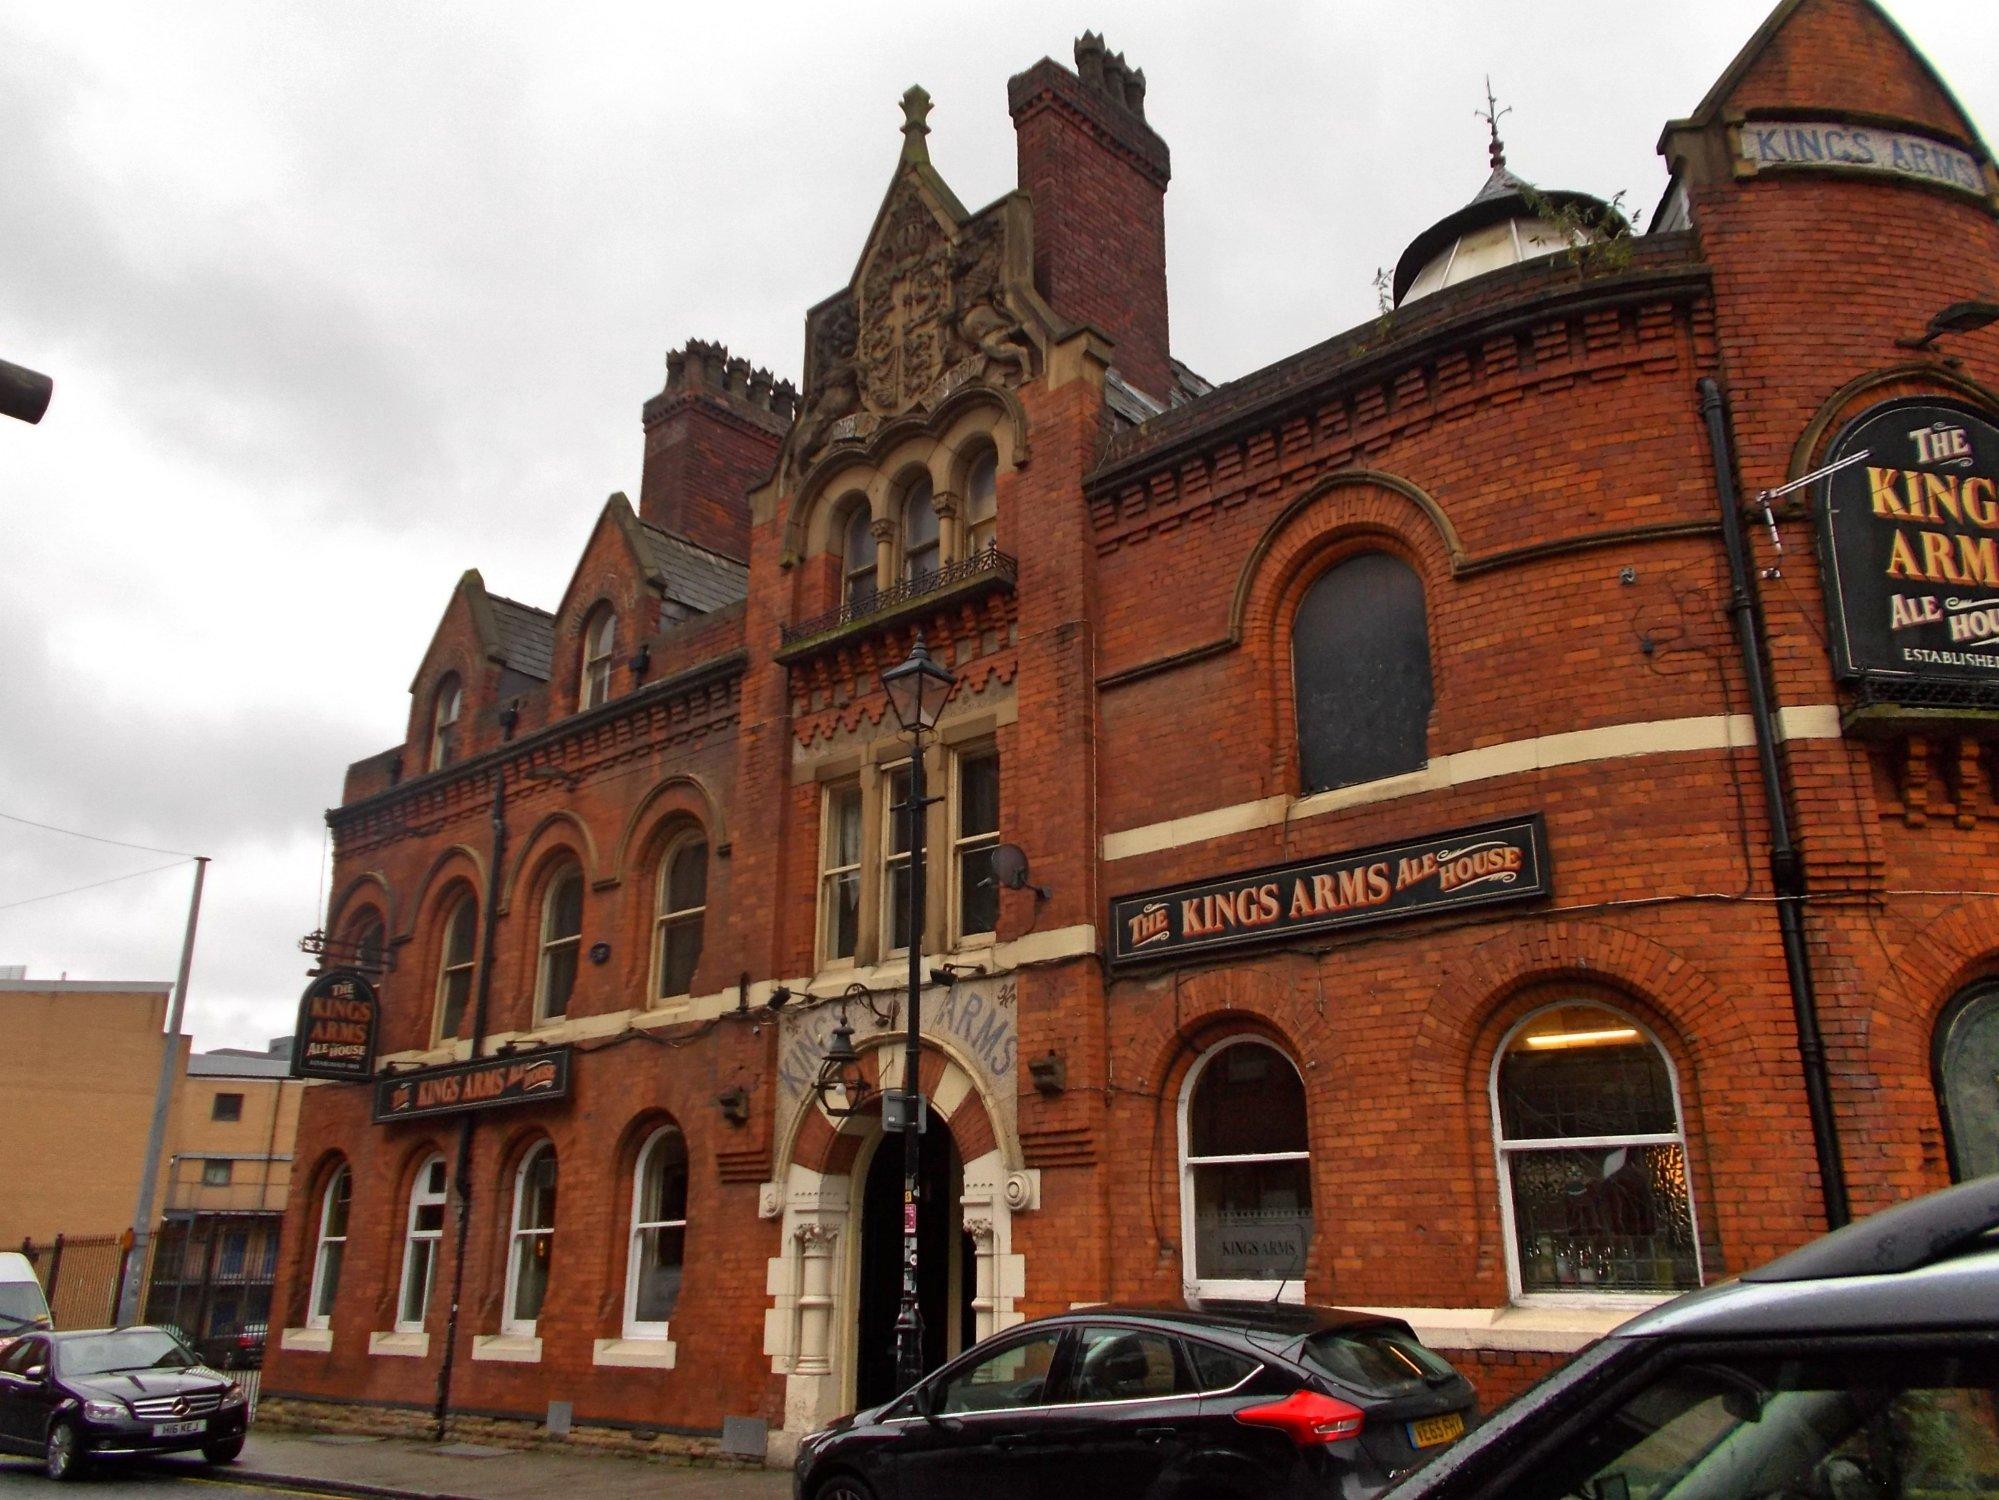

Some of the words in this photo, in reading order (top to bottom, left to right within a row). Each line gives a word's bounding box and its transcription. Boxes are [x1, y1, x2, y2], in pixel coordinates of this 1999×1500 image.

[1892, 138, 1977, 189] ARMS
[1909, 427, 1973, 464] THE
[1866, 466, 1999, 529] KING
[1886, 529, 1999, 589] ARM
[1891, 593, 1943, 631] ALE
[1949, 607, 1999, 643] HOU
[1128, 908, 1170, 946] THE
[1181, 883, 1280, 938] KINGS
[1288, 861, 1392, 919] ARMS
[1396, 852, 1439, 891] ALE
[1438, 846, 1524, 892] HOUSE
[309, 996, 372, 1022] KINGS
[331, 983, 355, 997] THE
[308, 1018, 367, 1045] ARMS
[937, 982, 1018, 1076] ARMS
[307, 1042, 329, 1056] ALE
[329, 1045, 367, 1057] HOUSE
[416, 1076, 460, 1107] KINGS
[460, 1069, 504, 1100] ARMS
[1222, 1240, 1259, 1256] KINGS
[1262, 1240, 1296, 1256] ARMS
